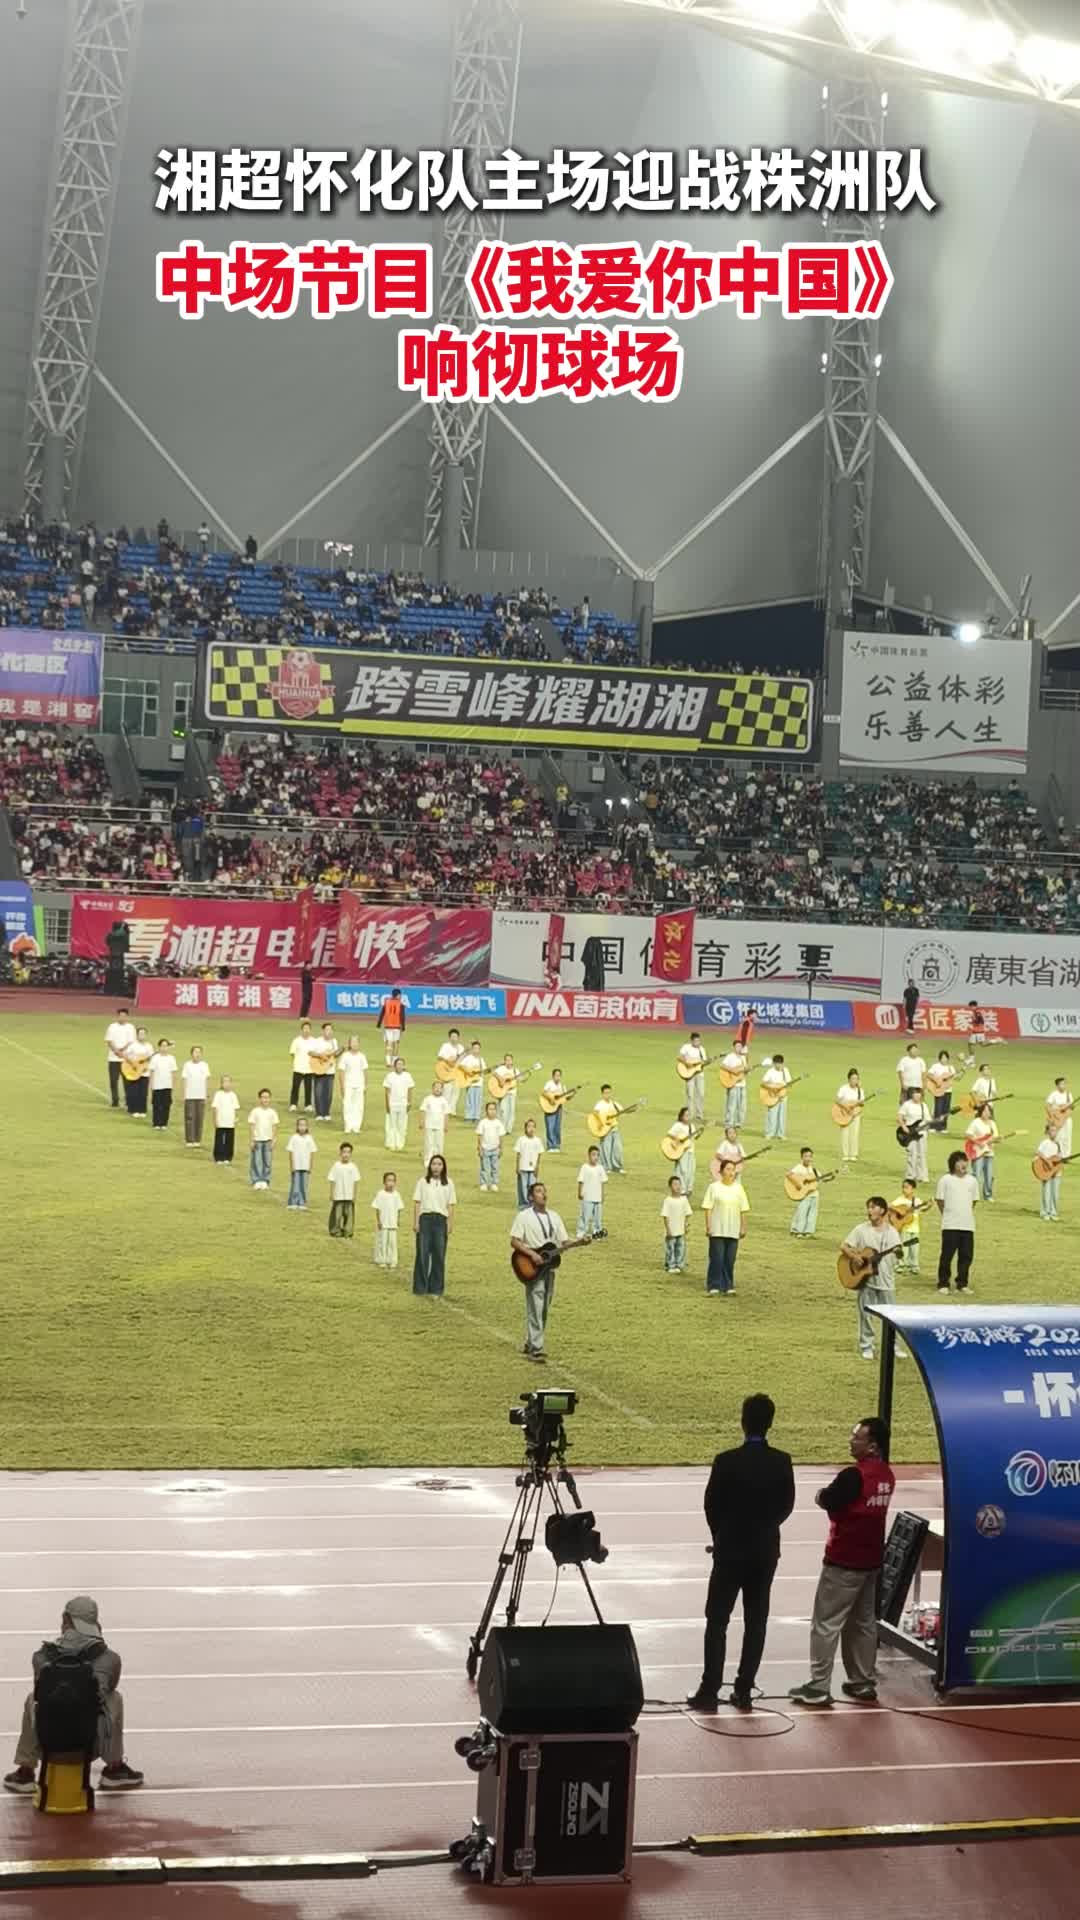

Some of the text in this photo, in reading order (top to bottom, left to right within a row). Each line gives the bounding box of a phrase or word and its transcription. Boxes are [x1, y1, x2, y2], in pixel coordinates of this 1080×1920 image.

[344, 665, 708, 731] 跨雪峰耀湖湘
[866, 670, 1005, 705] 公益体彩
[865, 710, 1003, 743] 乐善人生
[175, 982, 293, 1009] 湖南湘窖
[417, 994, 497, 1012] 上网快到飞
[1053, 1014, 1080, 1026] 中国
